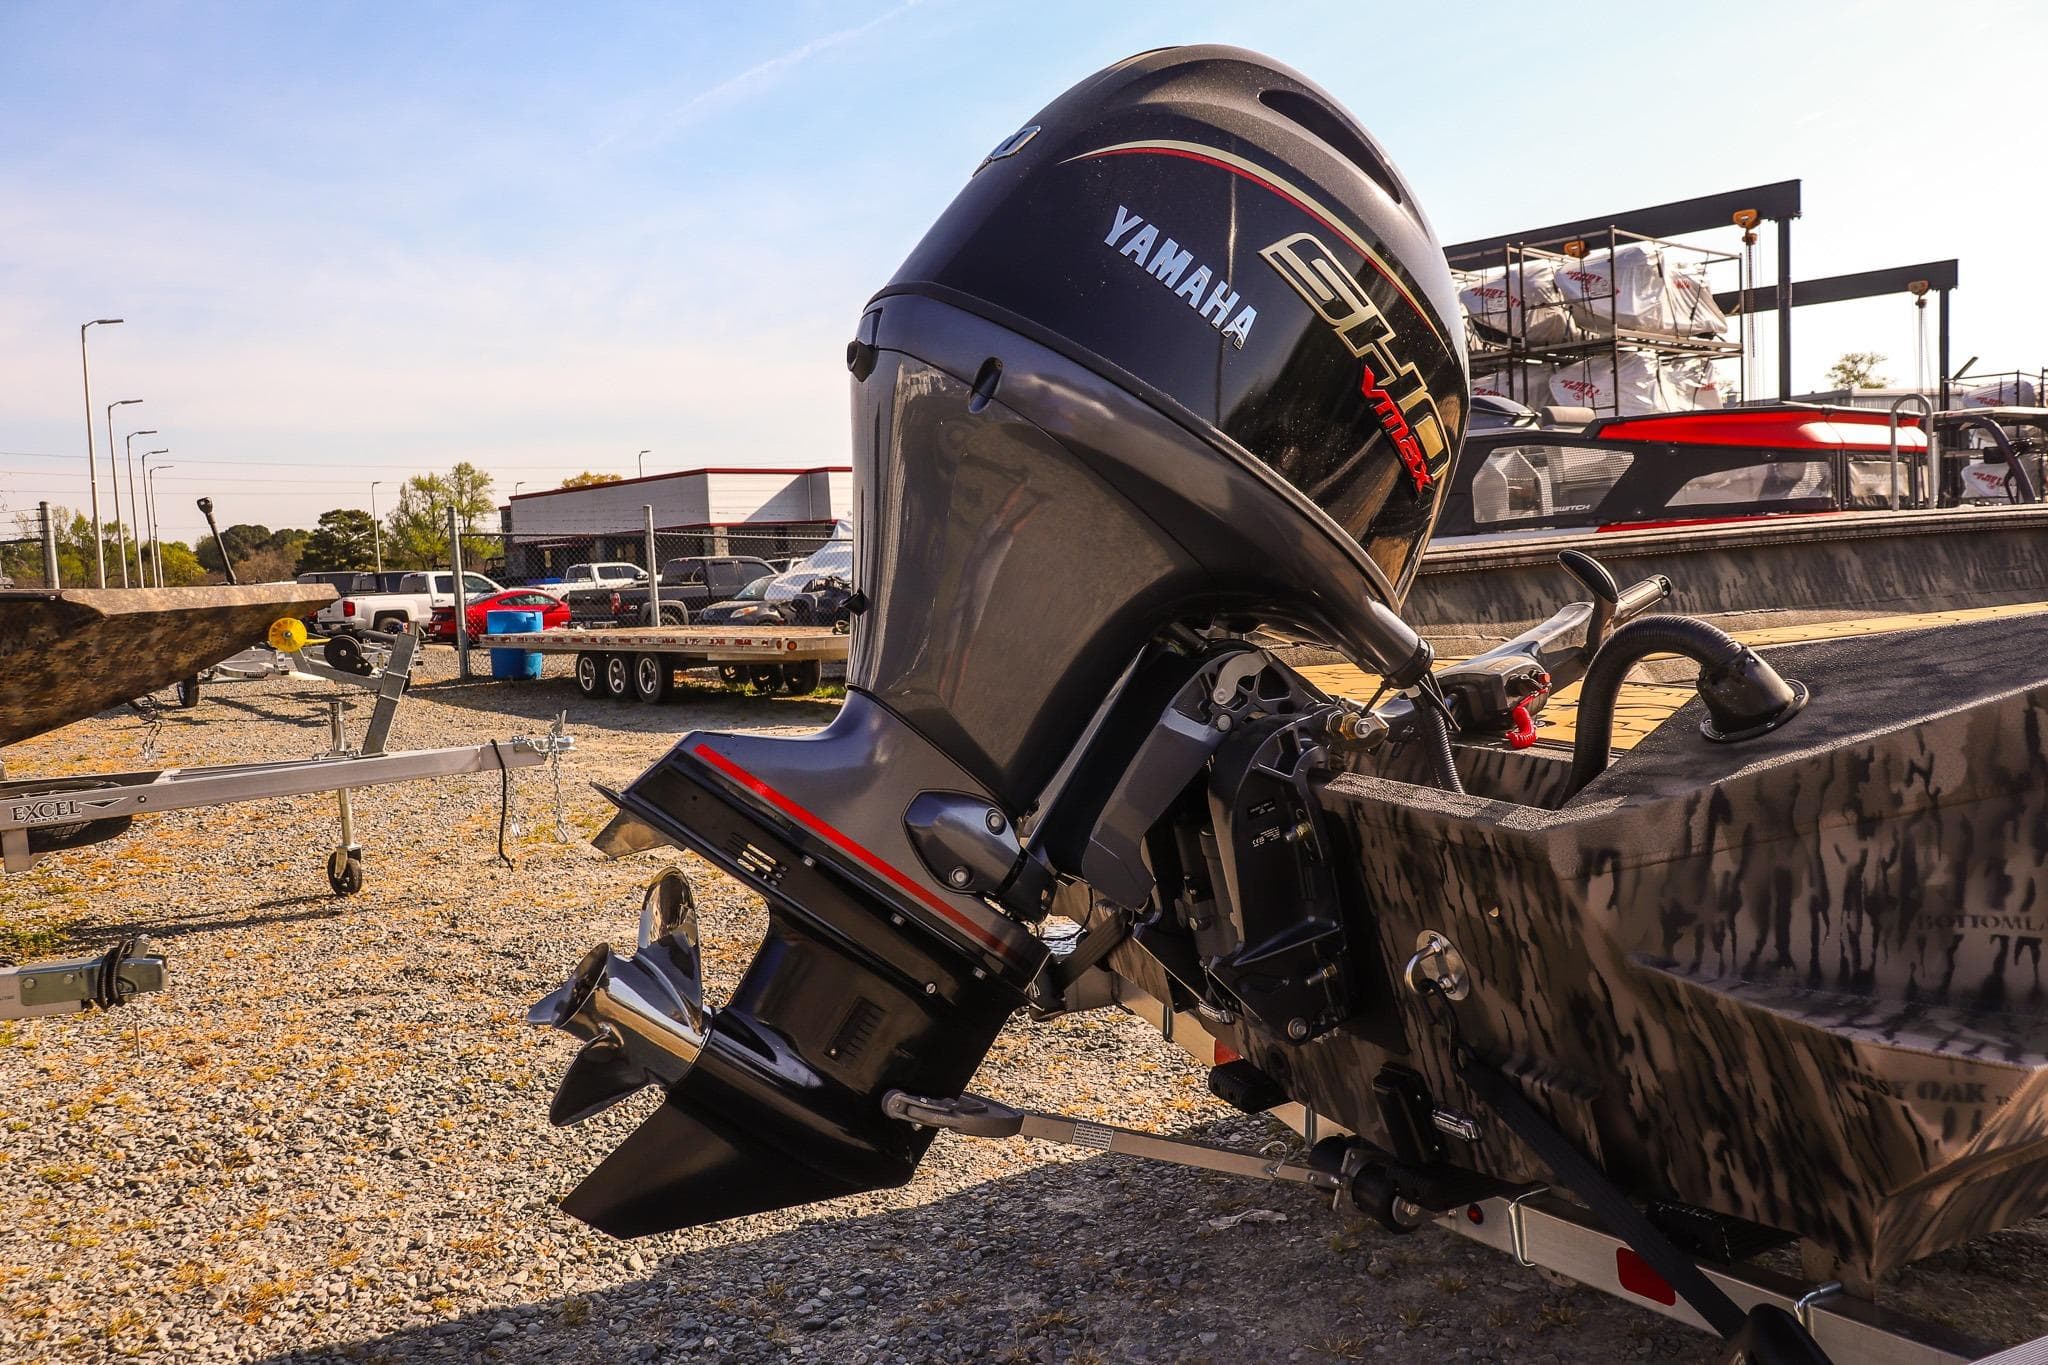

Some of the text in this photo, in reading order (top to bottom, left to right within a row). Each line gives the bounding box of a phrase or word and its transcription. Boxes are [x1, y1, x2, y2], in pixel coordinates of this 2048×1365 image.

[1104, 205, 1258, 349] YAMAHA
[11, 800, 82, 822] EXCEL
[1915, 1080, 1986, 1102] OAK
